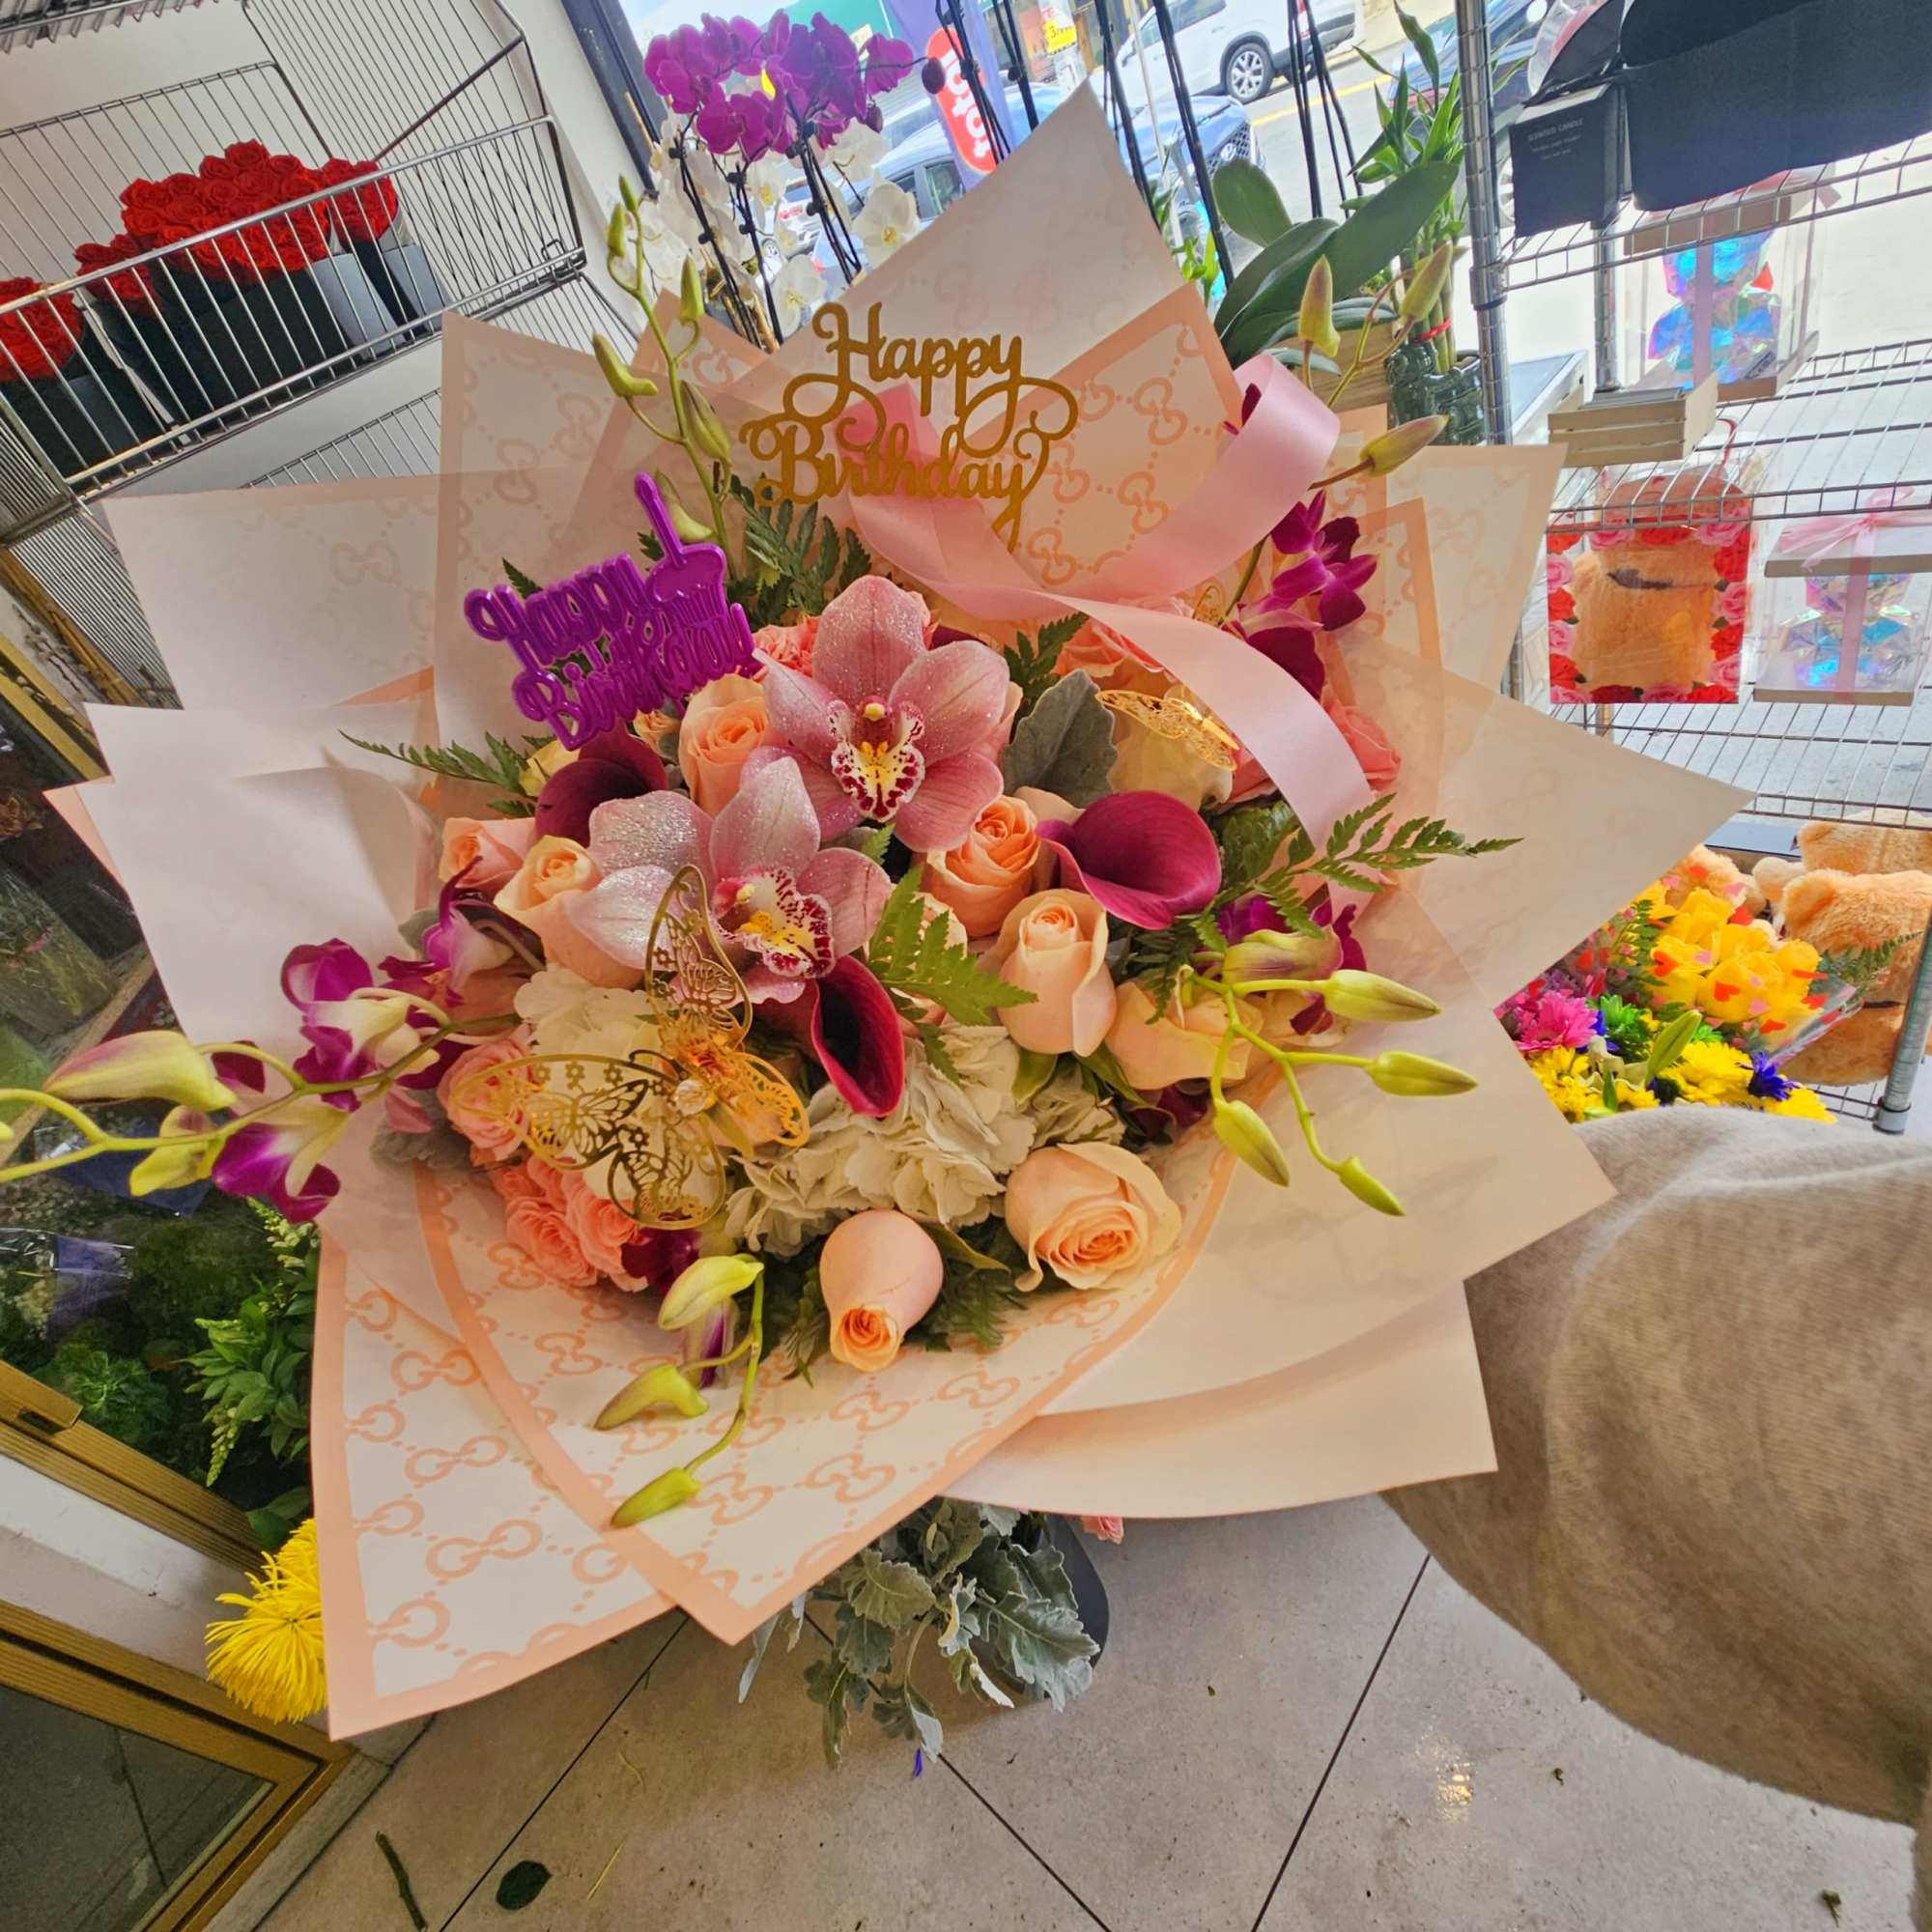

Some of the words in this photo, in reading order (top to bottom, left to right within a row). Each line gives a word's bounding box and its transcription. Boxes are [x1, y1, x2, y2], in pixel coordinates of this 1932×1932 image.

[782, 301, 1079, 459] Happy
[739, 412, 1050, 552] Birthday
[464, 553, 659, 667] Happy
[512, 603, 757, 751] Birthday
